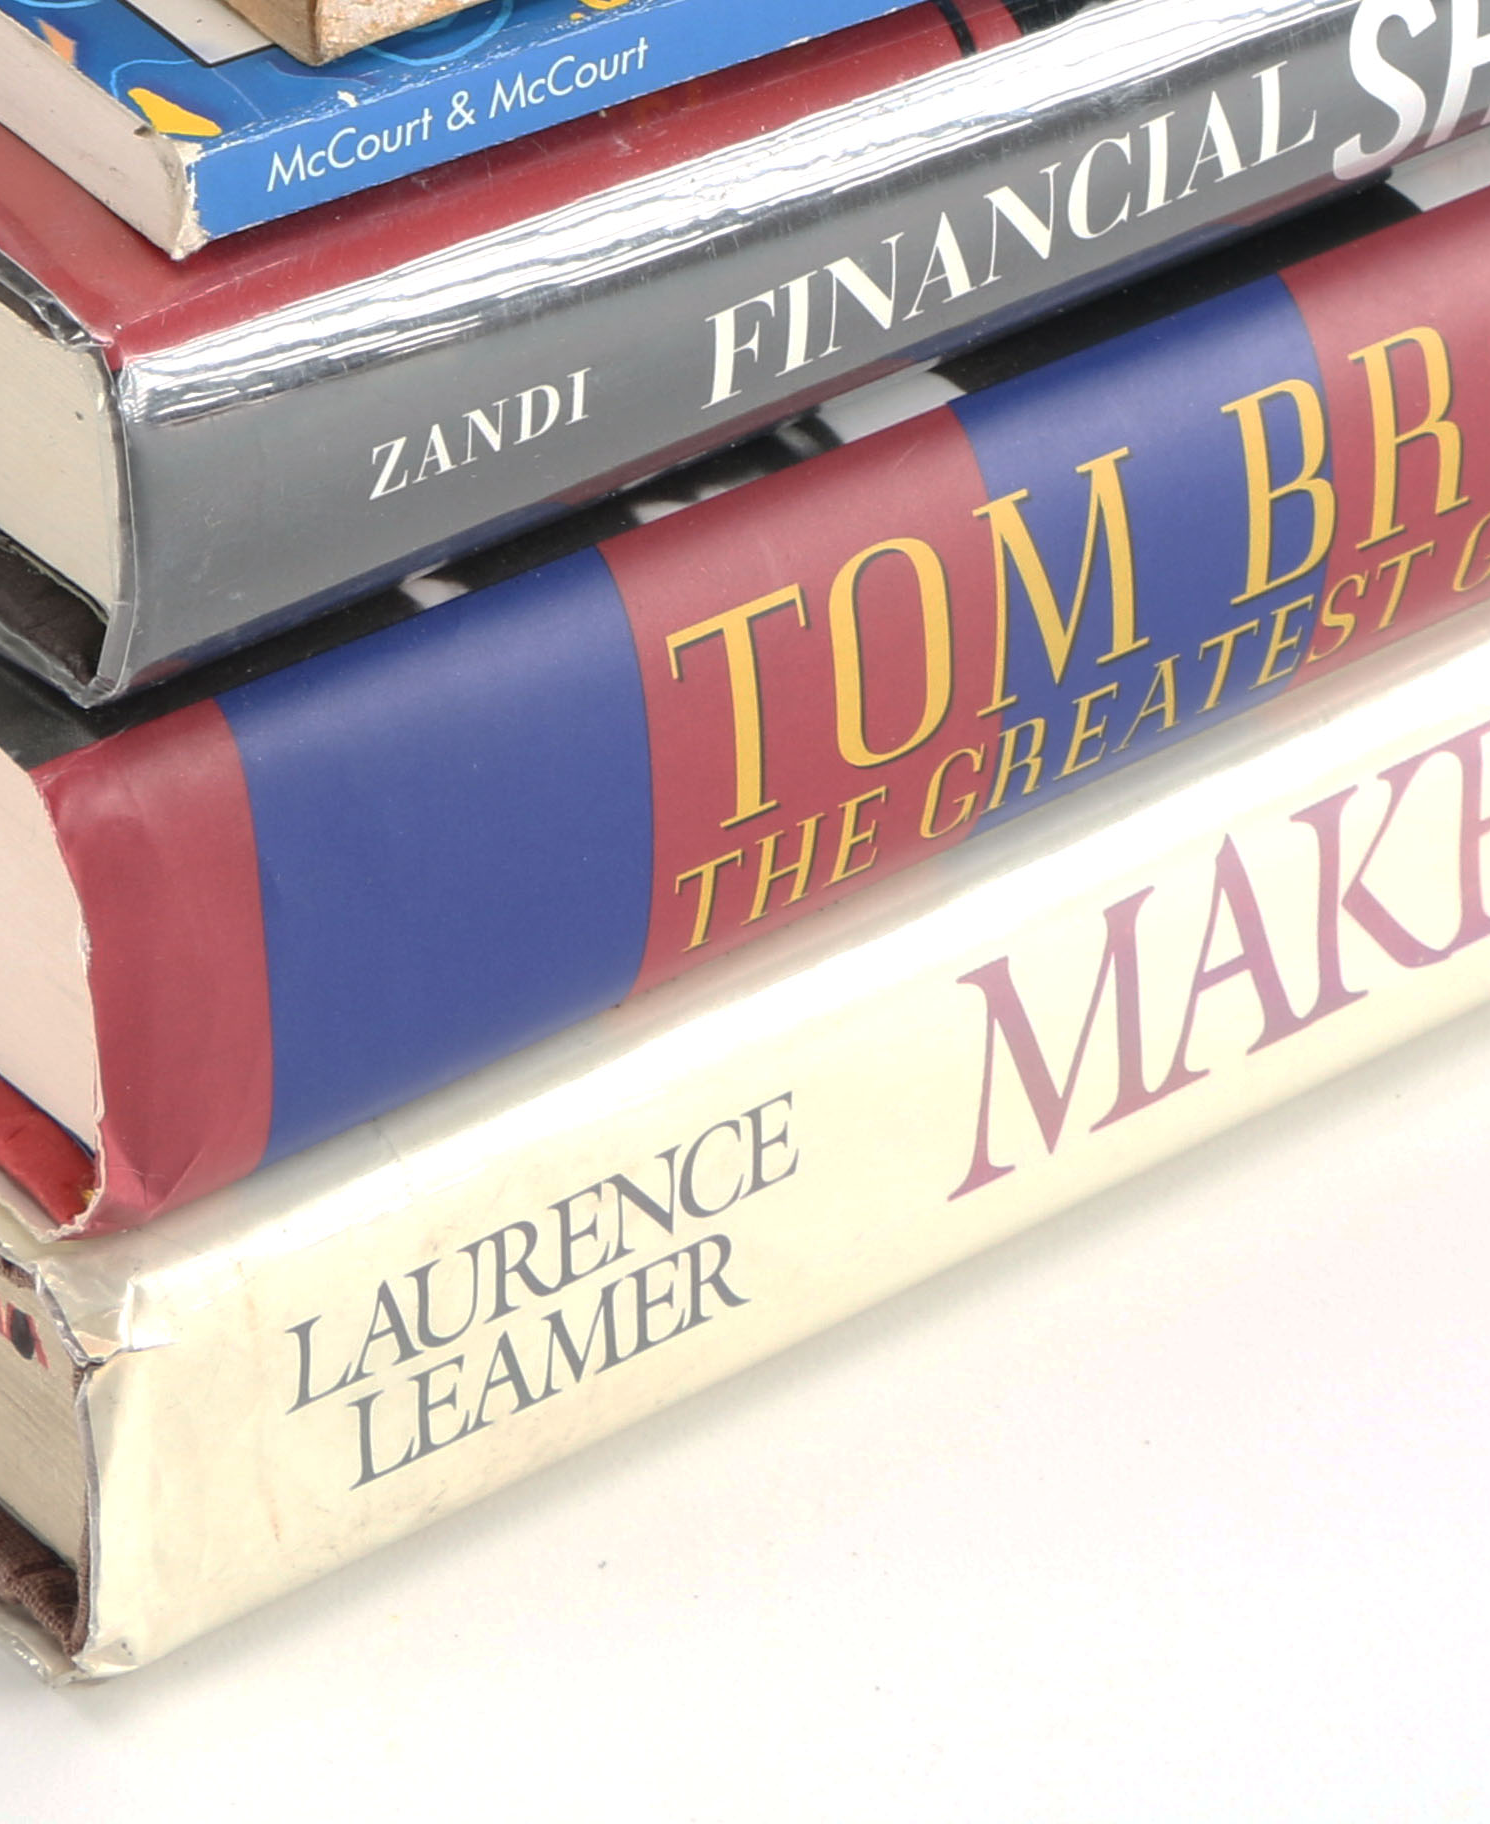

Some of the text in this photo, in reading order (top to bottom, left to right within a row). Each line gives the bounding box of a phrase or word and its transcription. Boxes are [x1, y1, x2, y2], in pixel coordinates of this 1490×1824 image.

[266, 37, 649, 193] McCourt & McCourt
[369, 366, 592, 501] ZANDI
[702, 60, 1318, 409] FINANCIAL
[665, 445, 1151, 832] TOM
[674, 785, 889, 953] THE
[919, 542, 1437, 843] GREATEST
[285, 1092, 800, 1414] LAURENCE
[347, 1231, 752, 1491] LEAMER
